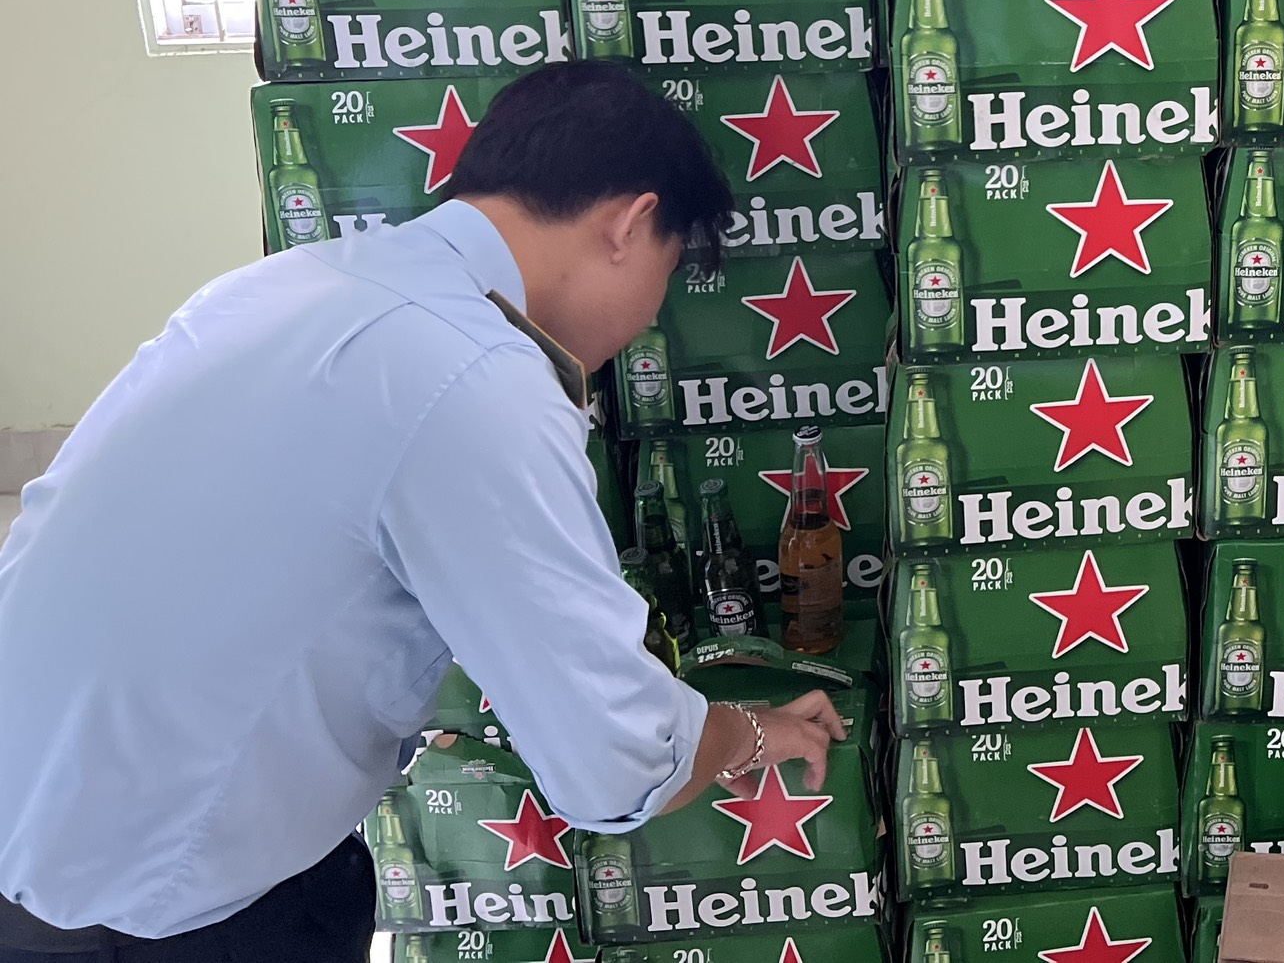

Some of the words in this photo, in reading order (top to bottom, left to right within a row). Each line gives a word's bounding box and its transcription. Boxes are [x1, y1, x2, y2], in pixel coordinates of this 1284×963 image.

[327, 10, 571, 68] Heinek
[637, 7, 872, 64] Heinek
[908, 83, 954, 94] Heineken
[332, 91, 363, 113] 20
[335, 115, 363, 124] PACK
[968, 87, 1219, 151] Heinek
[985, 165, 1018, 189] 20
[688, 192, 885, 249] einek
[1235, 268, 1278, 277] Heineken
[913, 289, 959, 299] Heineken
[970, 289, 1211, 352] Heinek
[971, 366, 1002, 390] 20
[706, 437, 734, 457] 20
[707, 457, 733, 466] PACK
[958, 478, 1193, 544] Heinek
[972, 558, 1002, 580] 20
[697, 643, 719, 655] DEPUIS
[958, 664, 1187, 726] Heinek
[426, 790, 452, 807] 20
[960, 829, 1180, 885] Heinek
[425, 882, 576, 927] Hein
[644, 872, 878, 931] Heinek
[458, 932, 484, 950] 20
[983, 918, 1012, 942] 20
[459, 951, 483, 959] PACK
[984, 942, 1011, 951] PACK
